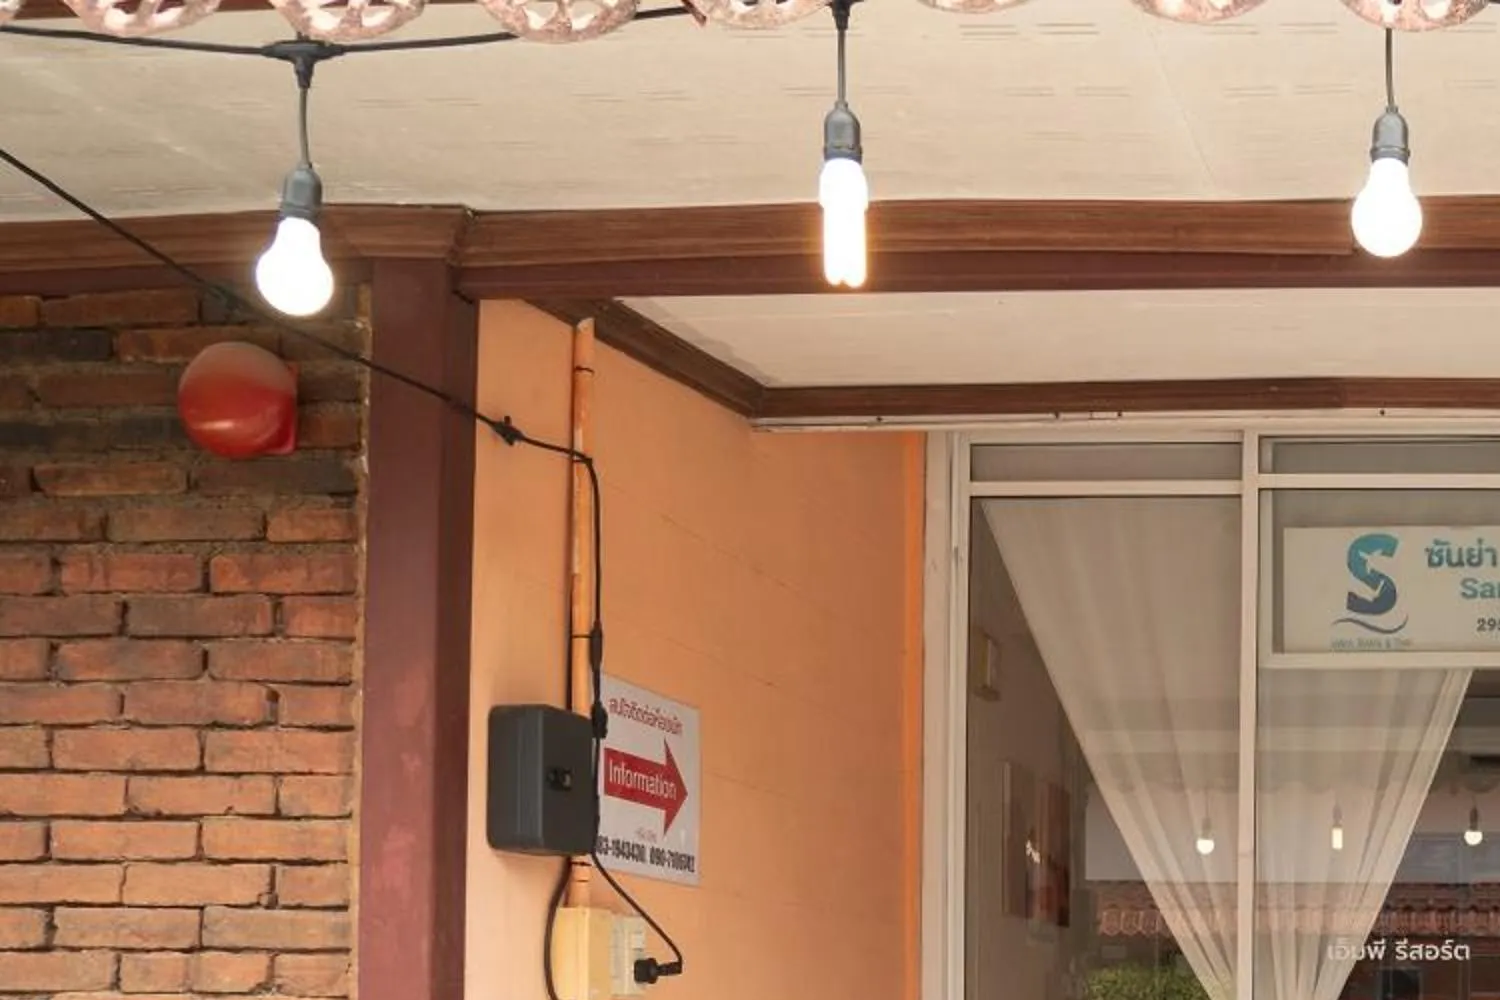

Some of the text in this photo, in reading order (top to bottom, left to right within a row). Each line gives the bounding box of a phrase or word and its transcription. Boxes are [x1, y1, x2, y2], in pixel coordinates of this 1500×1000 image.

[609, 757, 677, 800] Information
[1395, 938, 1472, 960] รีสอร์ต
